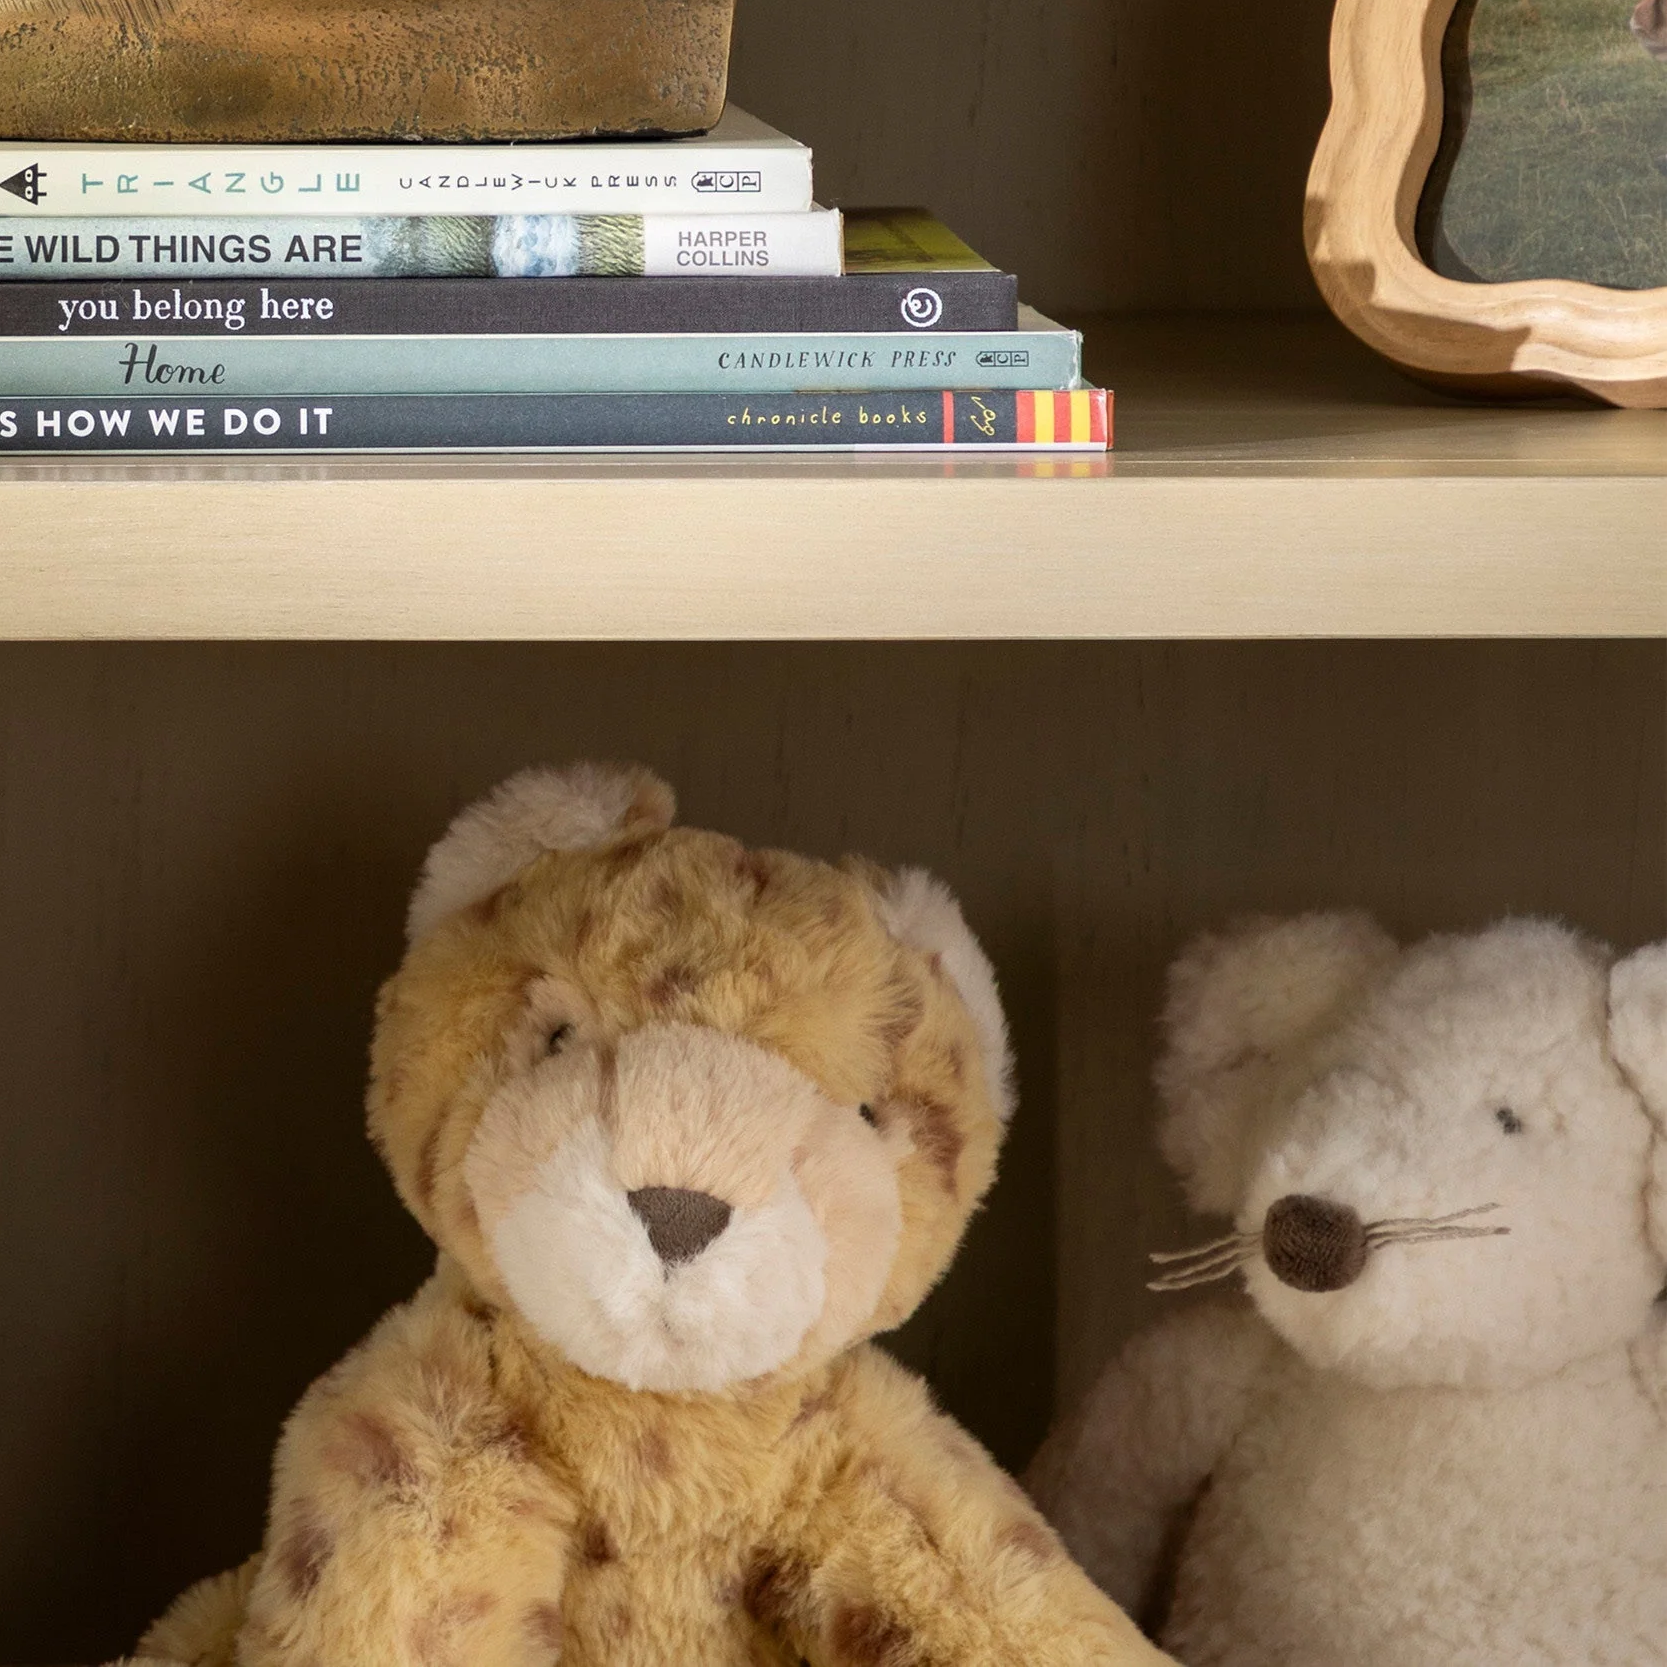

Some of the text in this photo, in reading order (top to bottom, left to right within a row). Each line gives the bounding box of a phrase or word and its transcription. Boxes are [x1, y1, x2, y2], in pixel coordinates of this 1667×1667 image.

[81, 171, 361, 194] TRIANGLE
[398, 174, 678, 191] CANDLEWICK PRESS
[24, 234, 121, 264] WILD
[129, 234, 272, 264] THINGS
[284, 234, 363, 264] ARE
[677, 230, 768, 248] HARPER
[676, 249, 770, 267] COLLINS
[58, 289, 335, 332] you belong here
[118, 342, 226, 386] Home
[717, 350, 958, 370] CANDLEWICK PRESS
[35, 408, 132, 438] HOW
[148, 408, 206, 437] WE
[223, 407, 282, 436] DO
[299, 407, 334, 435] IT
[727, 406, 927, 427] chronicle books
